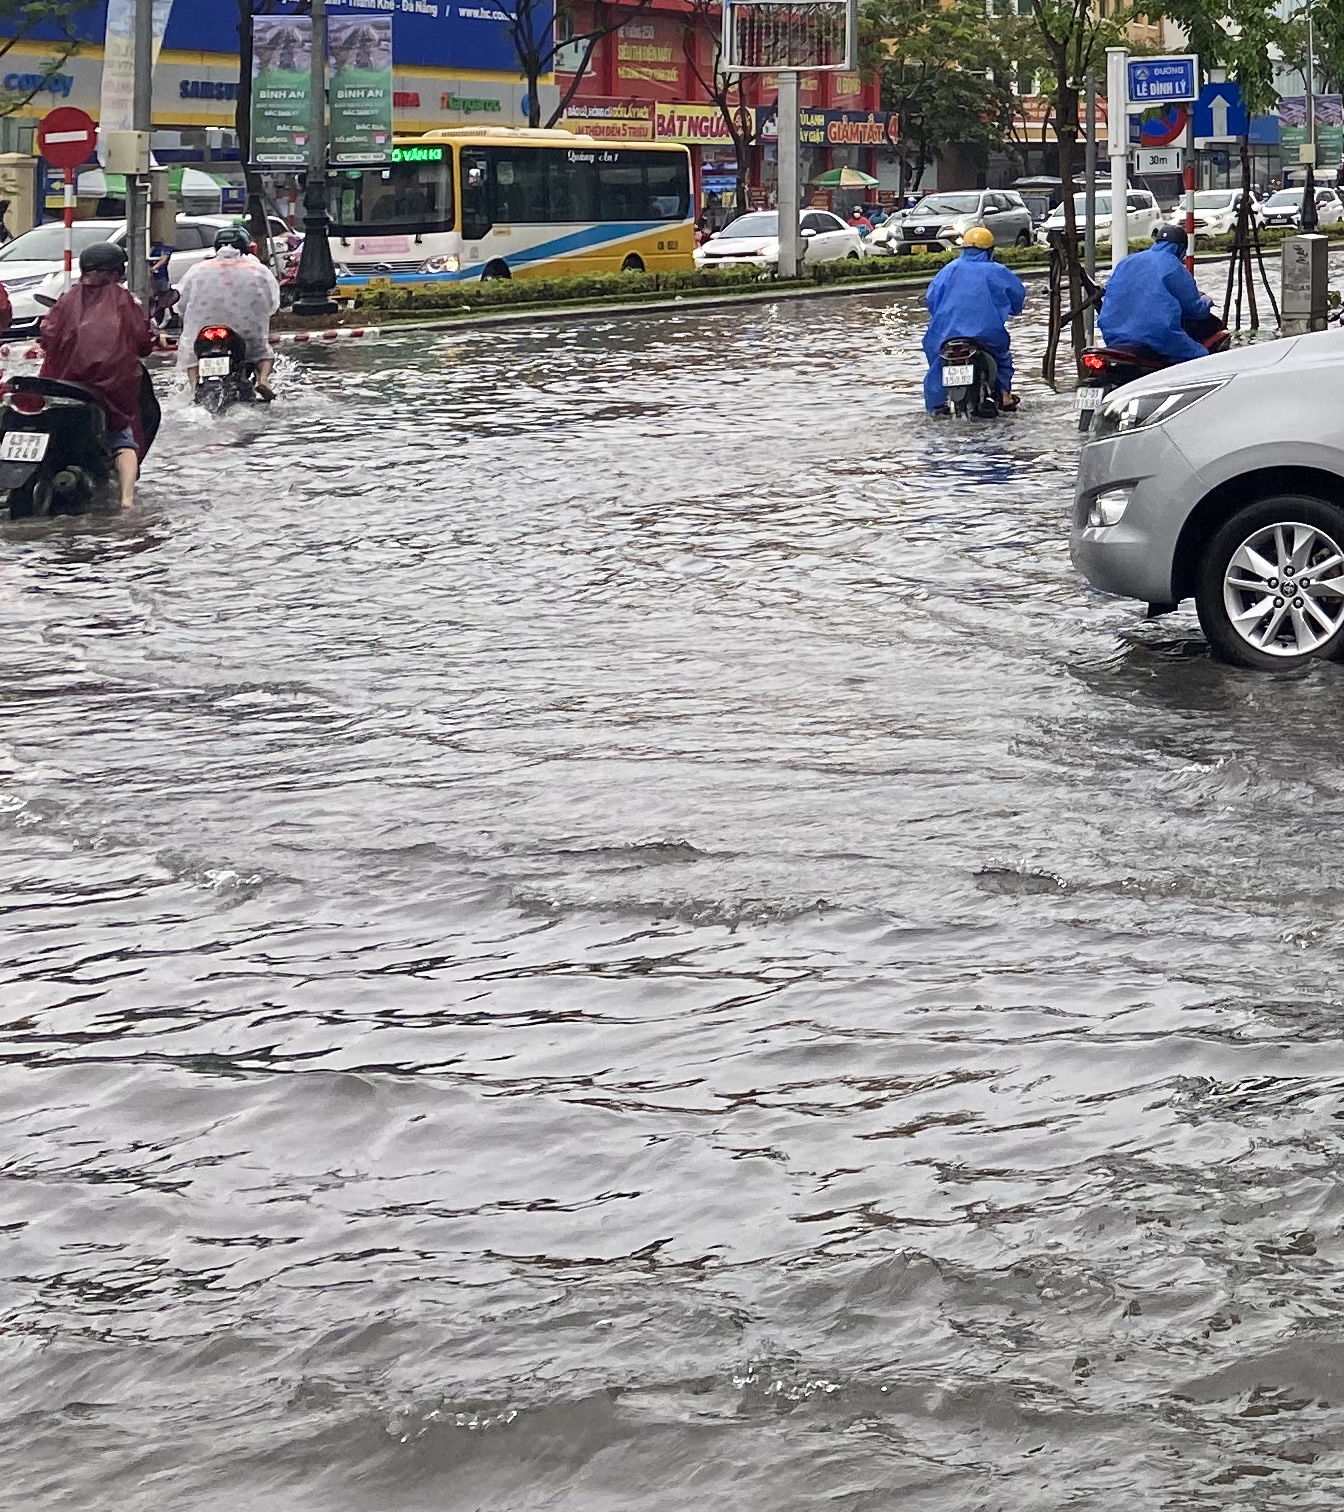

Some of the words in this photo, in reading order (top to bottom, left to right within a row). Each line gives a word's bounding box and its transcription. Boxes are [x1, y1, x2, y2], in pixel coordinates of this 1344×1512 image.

[402, 0, 414, 13] Đà
[415, 0, 438, 17] Nẵng
[1136, 82, 1149, 97] LÊ
[1150, 80, 1173, 96] ĐÌNH
[1175, 79, 1187, 95] LÝ
[259, 89, 287, 99] BÌNH
[288, 89, 305, 99] AN
[337, 89, 365, 99] BÌNH
[366, 89, 384, 99] AN
[1148, 155, 1168, 165] 30m
